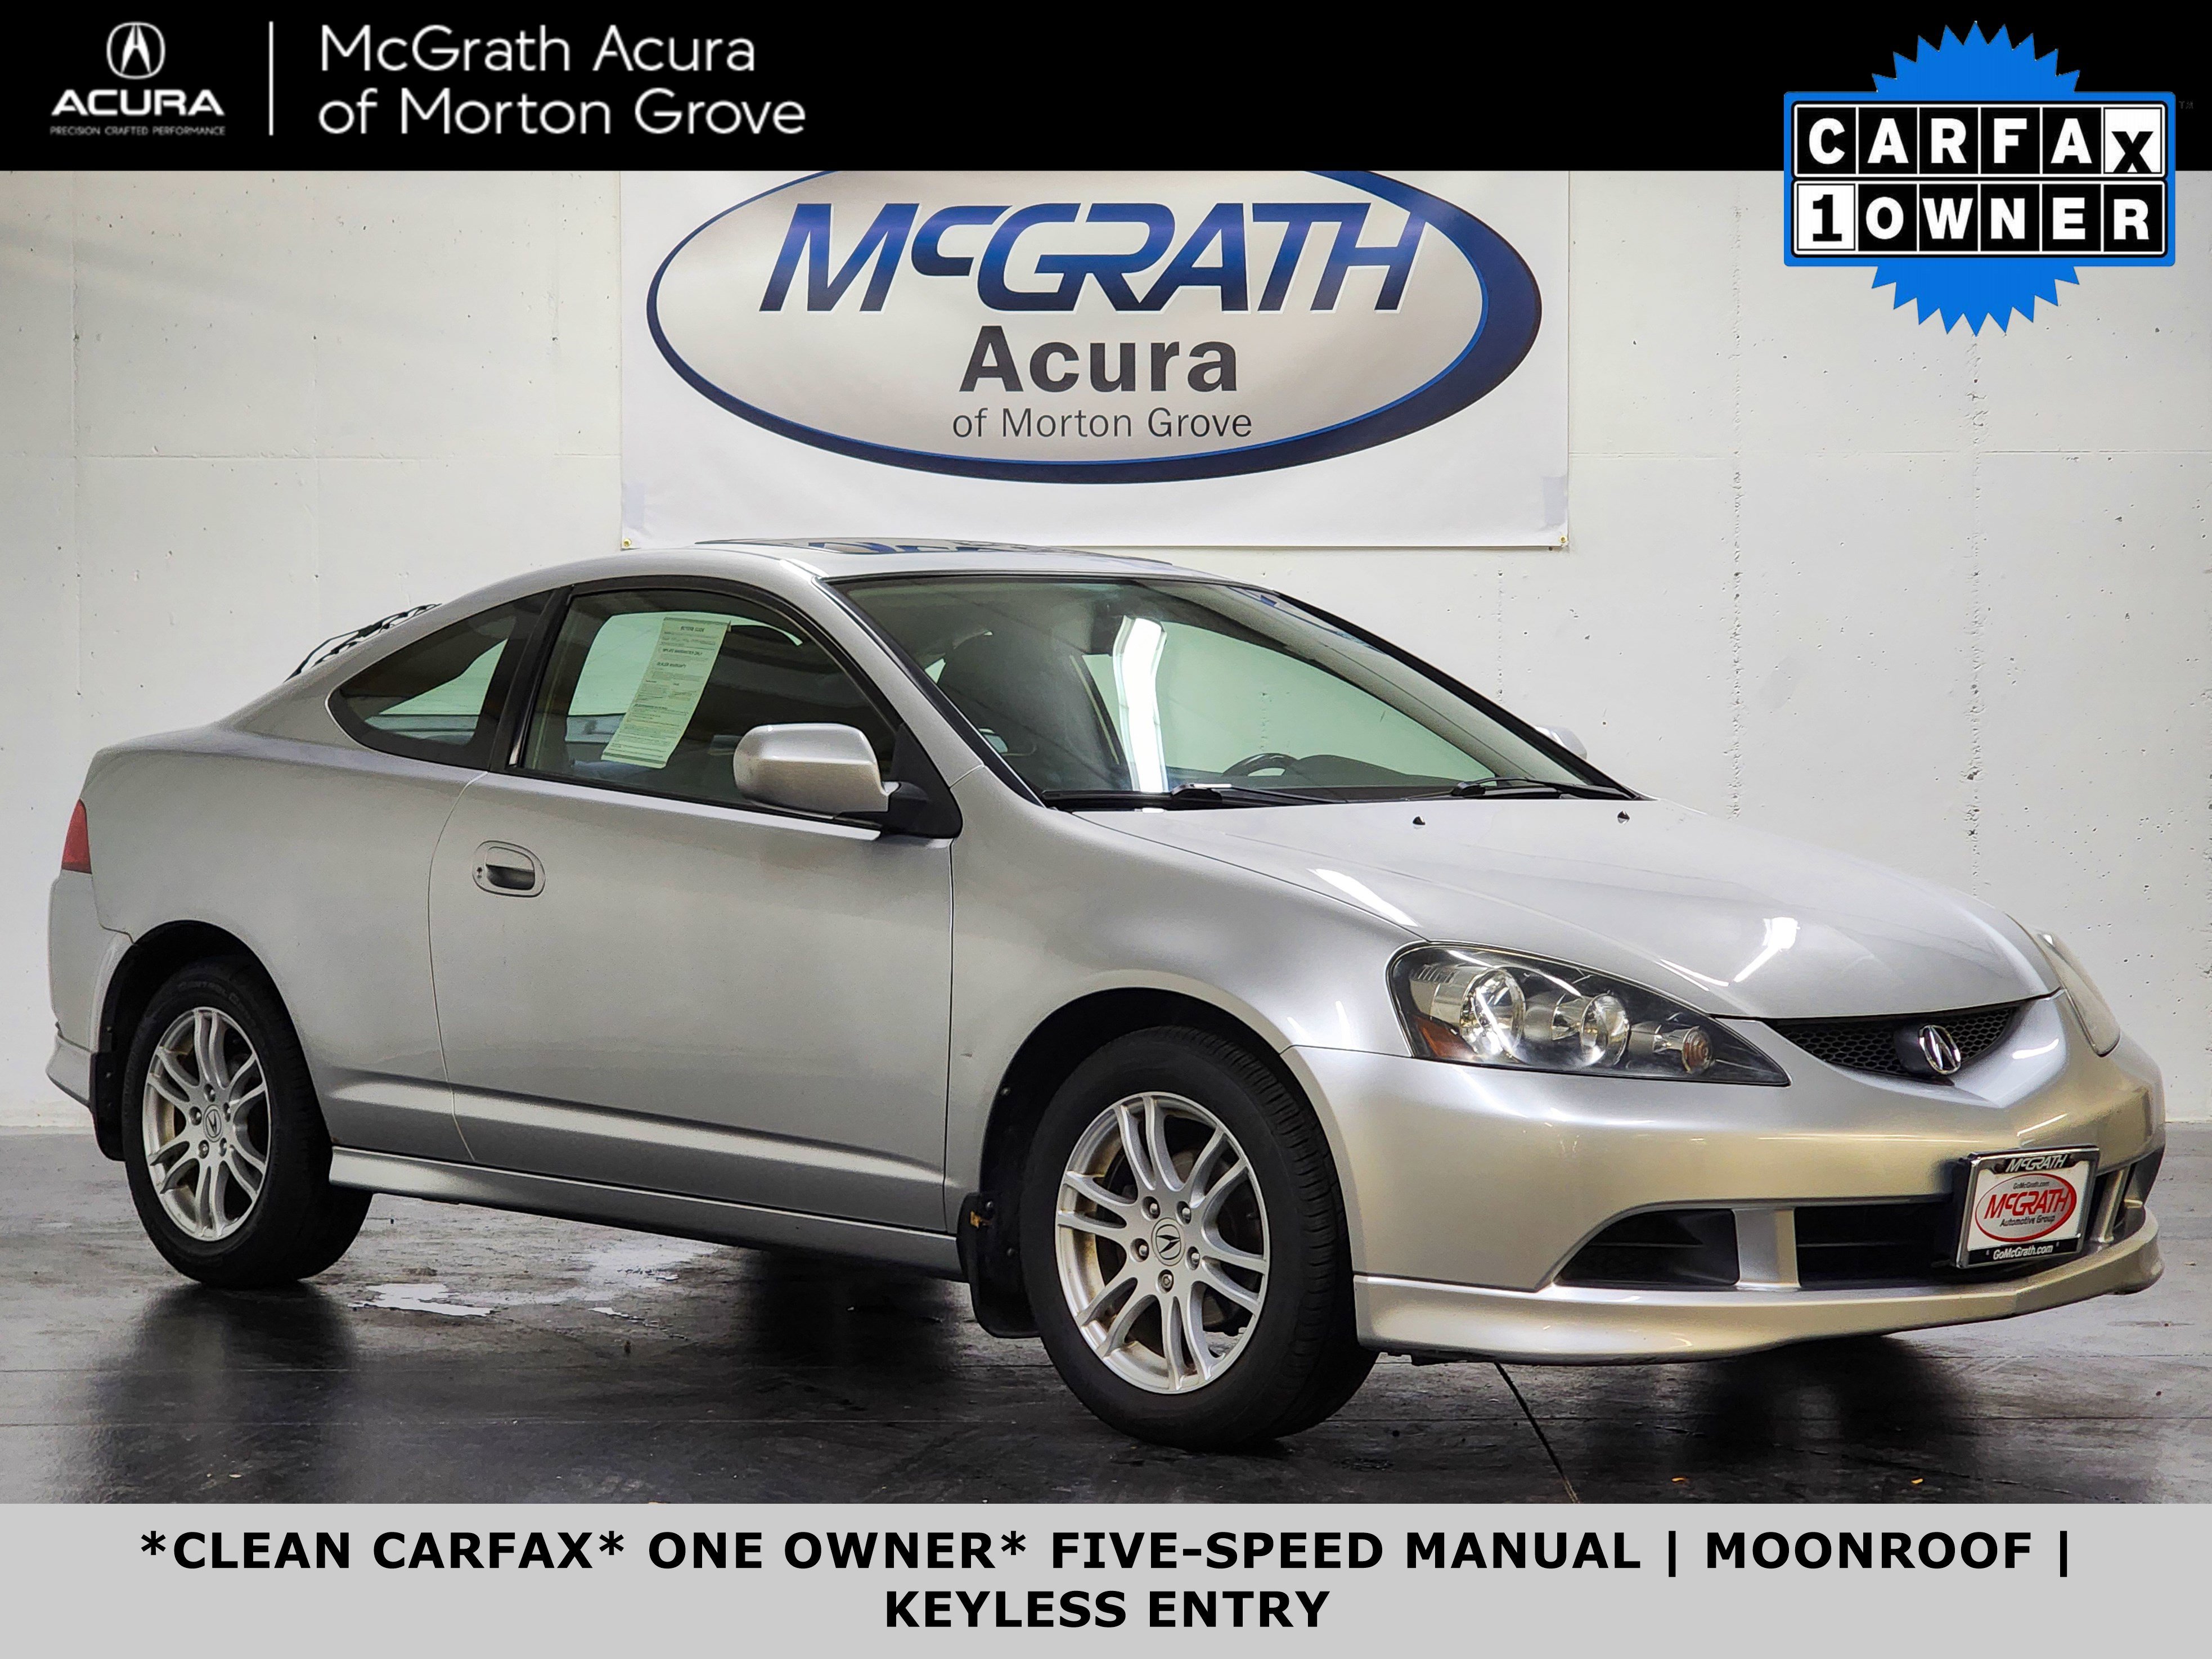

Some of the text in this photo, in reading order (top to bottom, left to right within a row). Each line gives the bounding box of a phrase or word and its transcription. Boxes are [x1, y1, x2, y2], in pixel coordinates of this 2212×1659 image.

[959, 325, 1238, 393] Acura
[953, 407, 1253, 438] of Morton Grove
[1993, 1245, 2053, 1260] GoMcGrath.com
